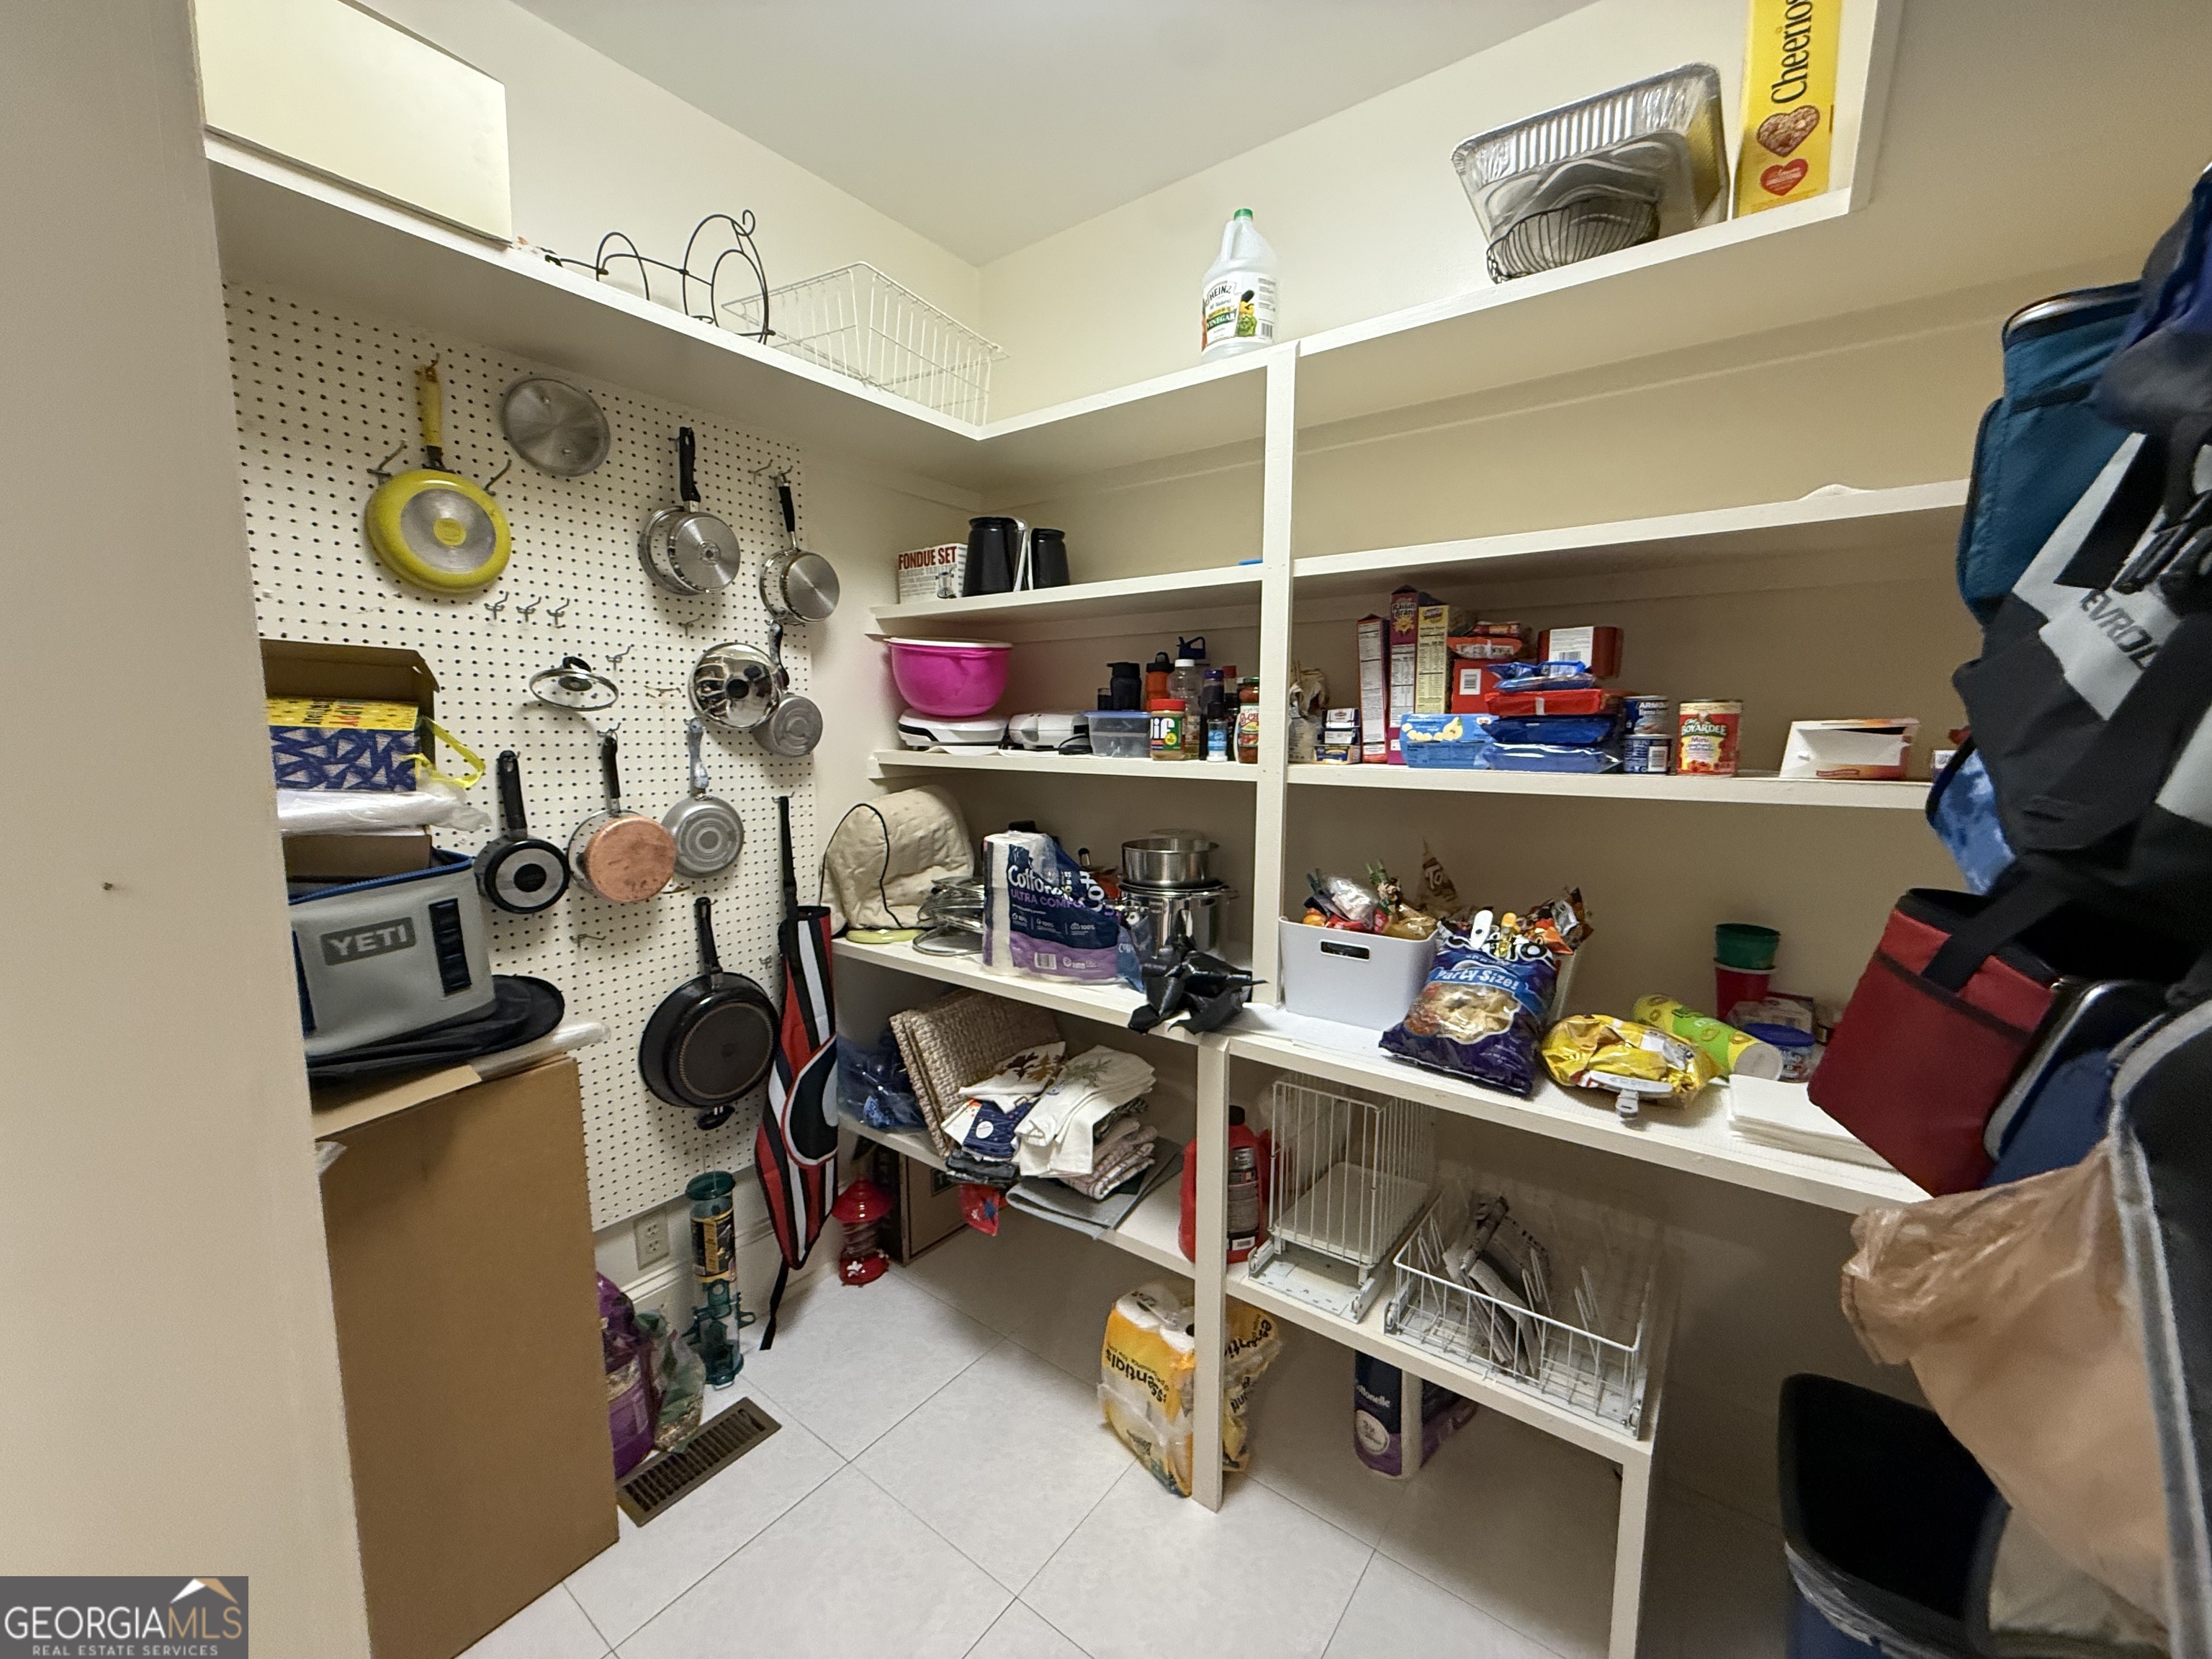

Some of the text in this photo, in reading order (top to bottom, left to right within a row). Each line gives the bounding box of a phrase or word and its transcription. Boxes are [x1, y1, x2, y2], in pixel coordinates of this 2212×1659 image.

[1771, 0, 1812, 103] Cheerio
[1210, 285, 1232, 301] HEINZ
[899, 546, 957, 570] FONDUE SET
[1392, 603, 1416, 612] Raisin
[2080, 589, 2160, 669] EVROL
[1681, 723, 1727, 736] BOYARDEE
[1010, 889, 1087, 909] ULTRA COMFO
[328, 925, 408, 956] YETI
[1435, 968, 1520, 990] Party Size!
[1106, 1349, 1166, 1403] ssentials
